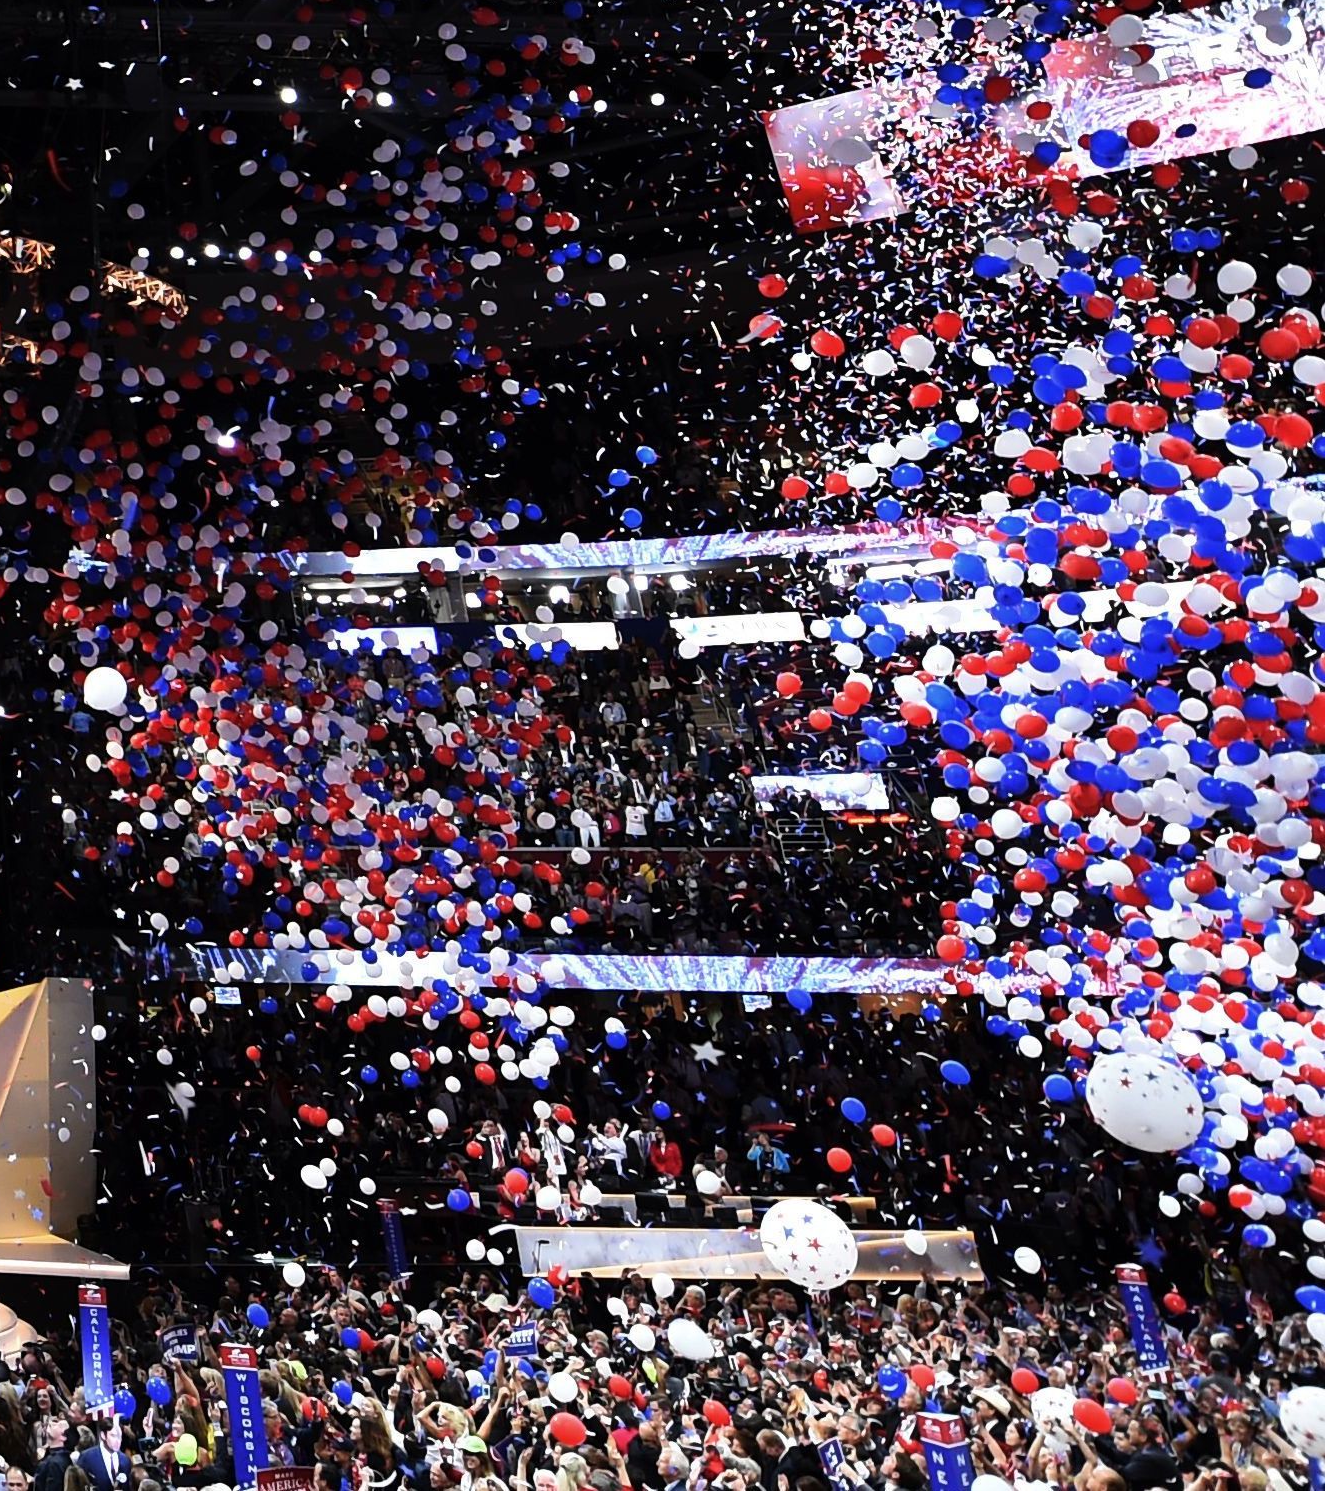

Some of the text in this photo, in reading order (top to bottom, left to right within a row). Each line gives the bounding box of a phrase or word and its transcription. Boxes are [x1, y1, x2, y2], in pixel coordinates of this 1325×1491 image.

[89, 1308, 104, 1397] CALIFORNIA
[1129, 1285, 1158, 1361] MARYLAND
[235, 1372, 258, 1475] WISCONSIN
